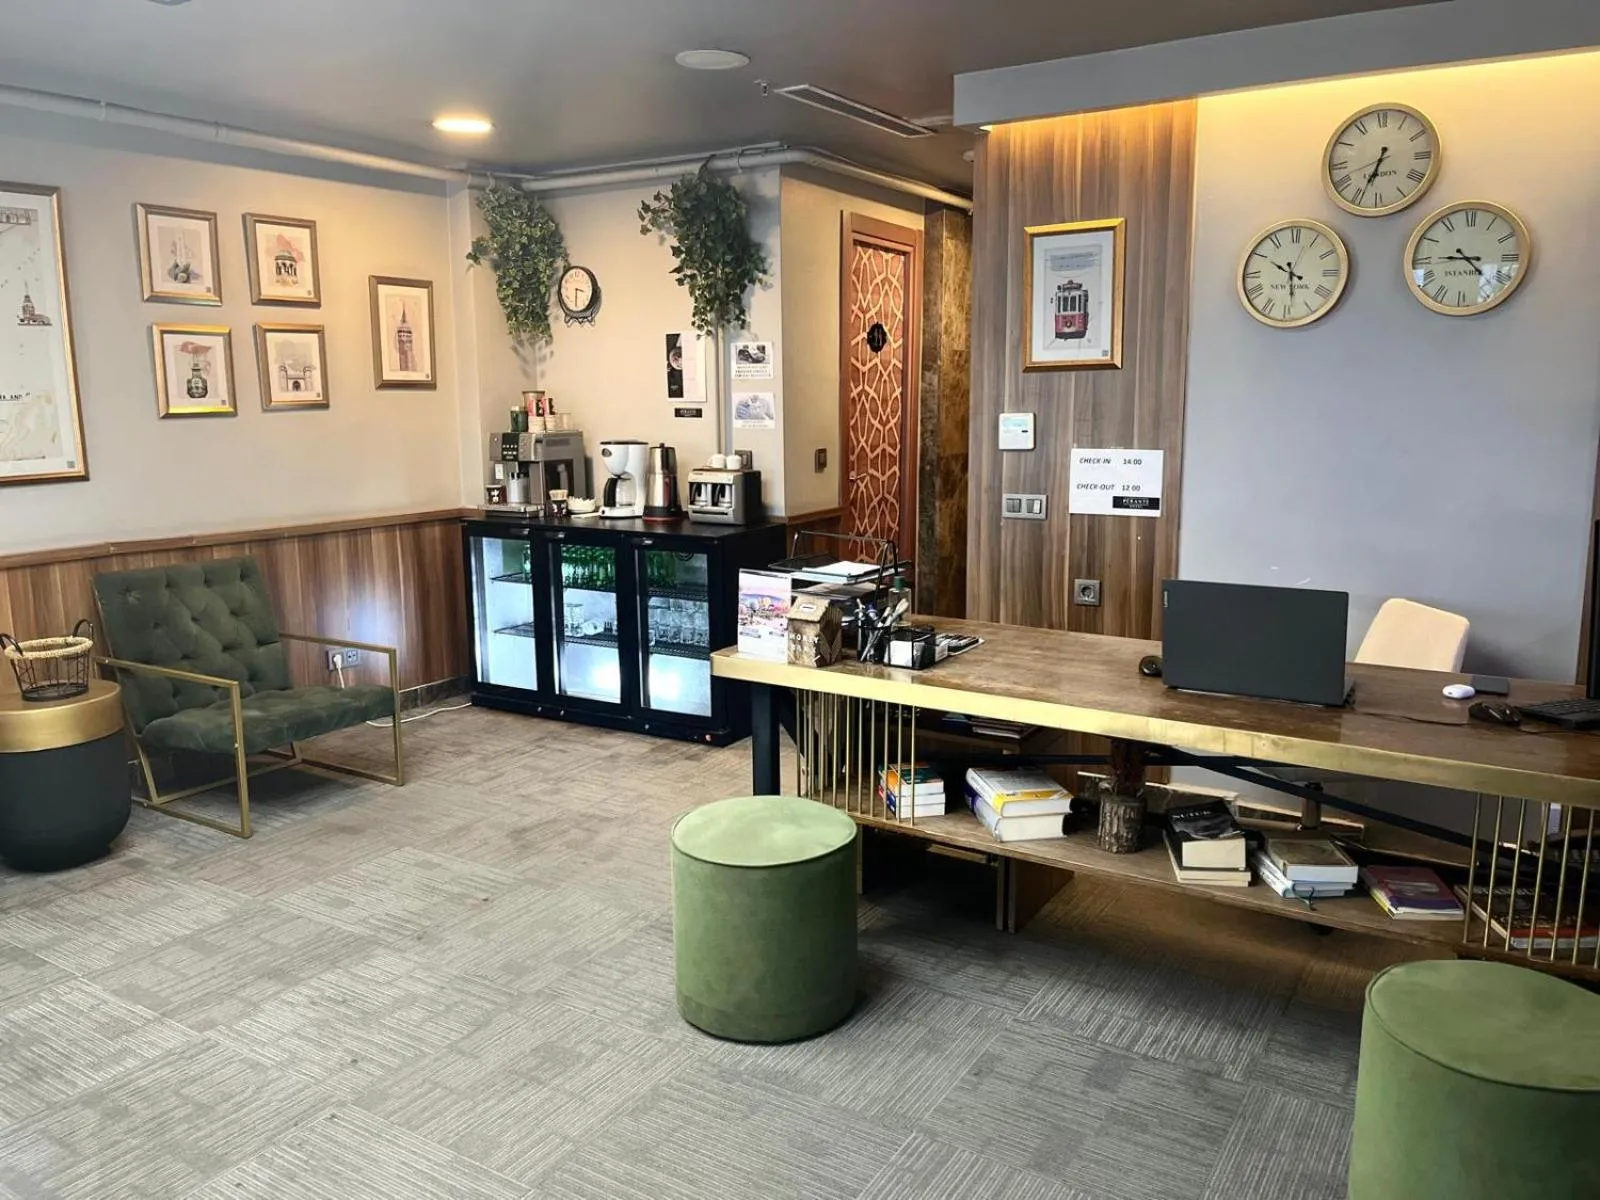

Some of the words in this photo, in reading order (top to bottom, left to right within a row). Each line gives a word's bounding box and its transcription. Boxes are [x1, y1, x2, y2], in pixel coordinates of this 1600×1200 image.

[1363, 169, 1397, 179] LDON
[1444, 268, 1481, 277] ISTANB
[1079, 457, 1101, 465] CHECK
[1122, 484, 1141, 492] 1200
